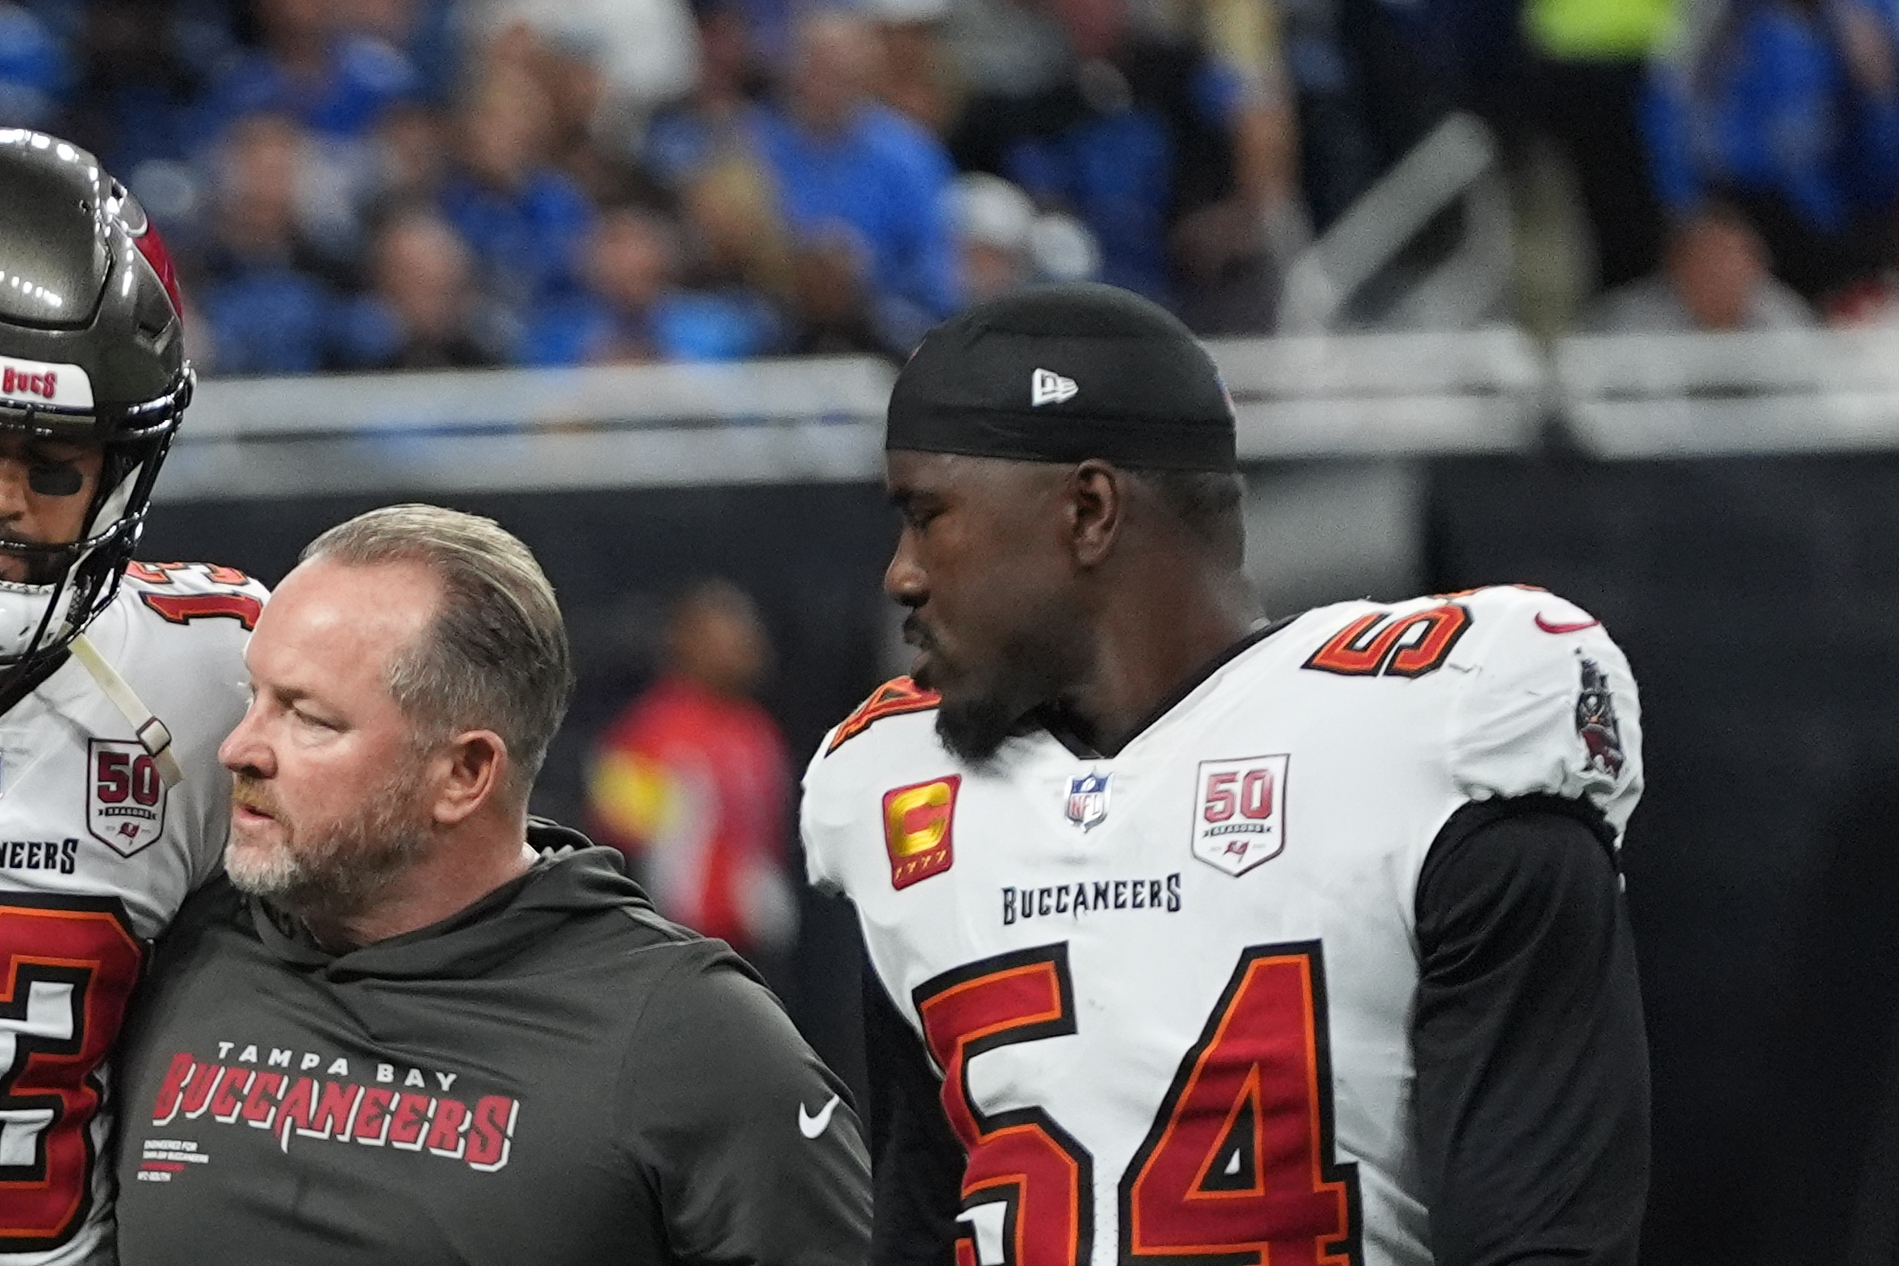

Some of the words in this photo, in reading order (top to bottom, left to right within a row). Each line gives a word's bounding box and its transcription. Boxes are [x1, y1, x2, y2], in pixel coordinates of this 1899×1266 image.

[2, 366, 57, 399] BUCS
[98, 752, 160, 807] 50
[1072, 794, 1100, 818] NFL
[1204, 769, 1273, 823] 50
[1002, 872, 1181, 926] BUCCANEERS
[218, 1041, 349, 1076] TAMPA
[376, 1063, 458, 1092] BAY
[153, 1052, 520, 1172] BUCCANEERS
